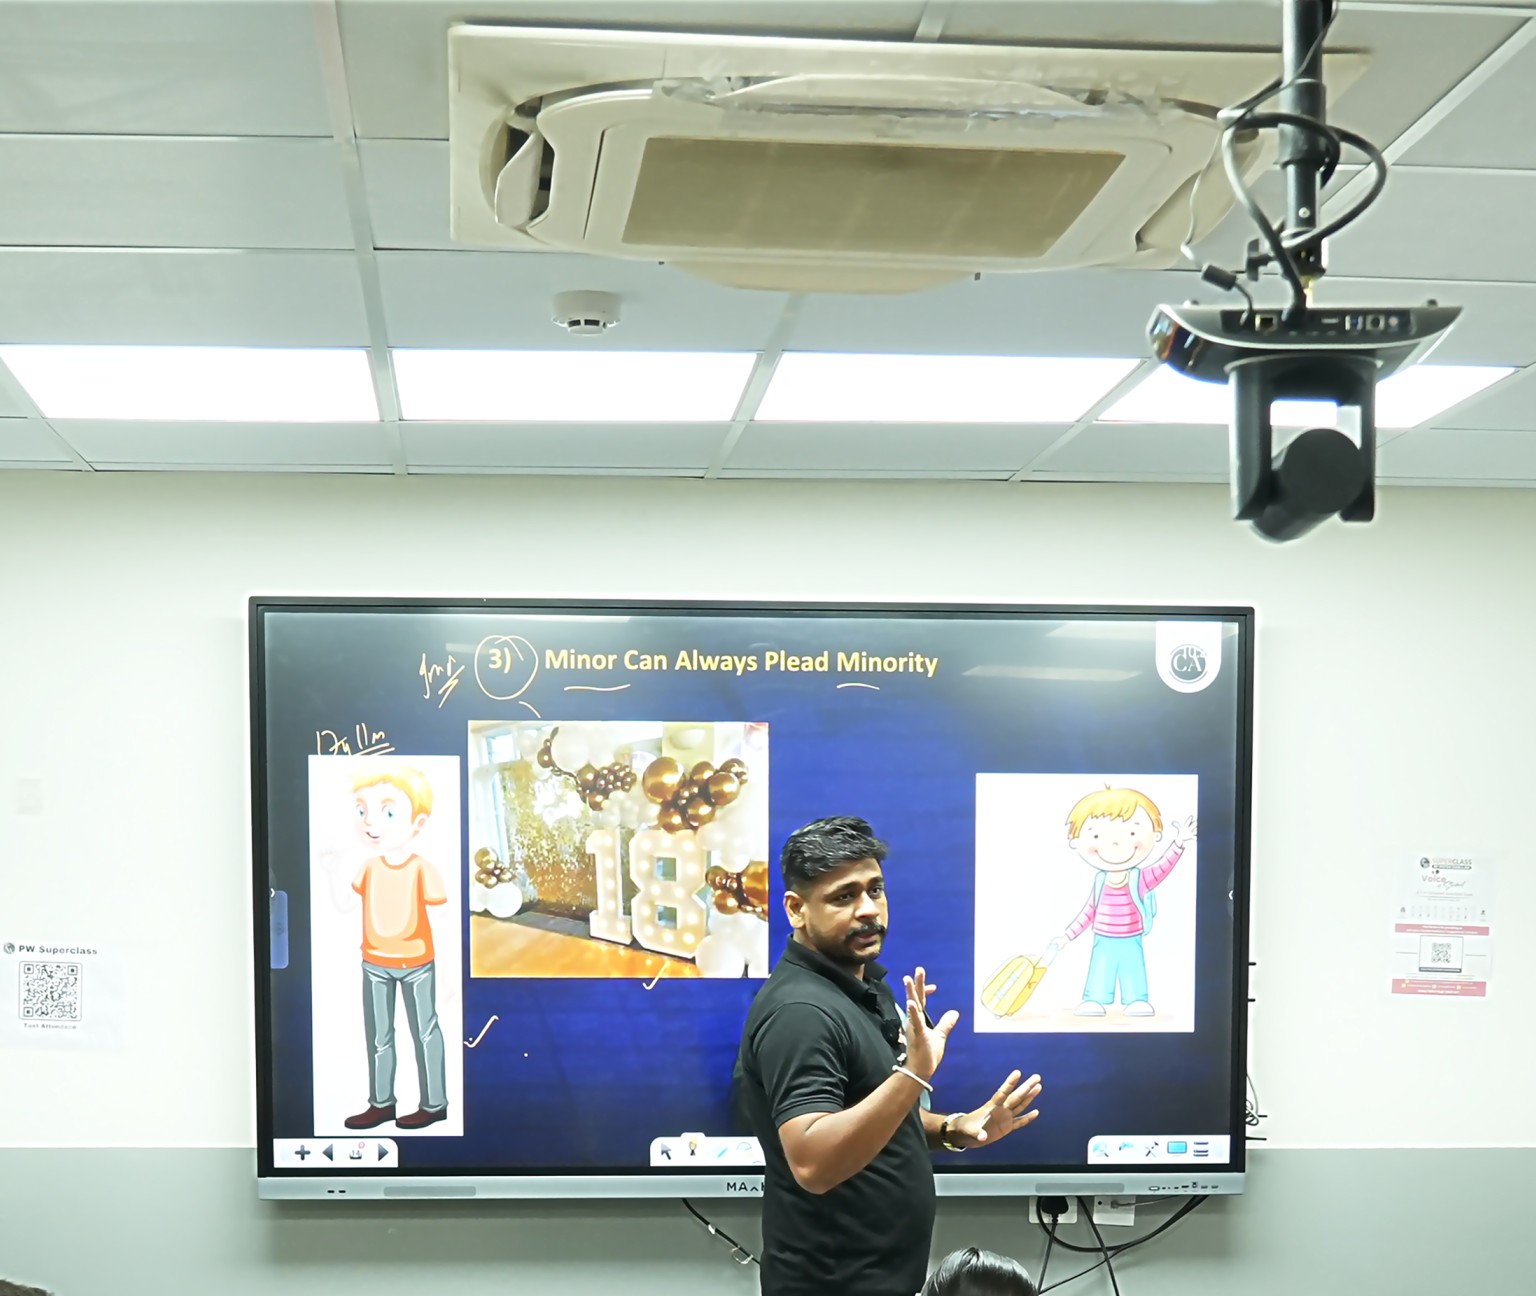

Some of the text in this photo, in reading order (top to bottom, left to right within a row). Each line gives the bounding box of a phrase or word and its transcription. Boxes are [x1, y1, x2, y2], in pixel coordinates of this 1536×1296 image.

[488, 648, 938, 677] 3) Minor Can Always Plead Minority
[39, 945, 97, 955] Superclass
